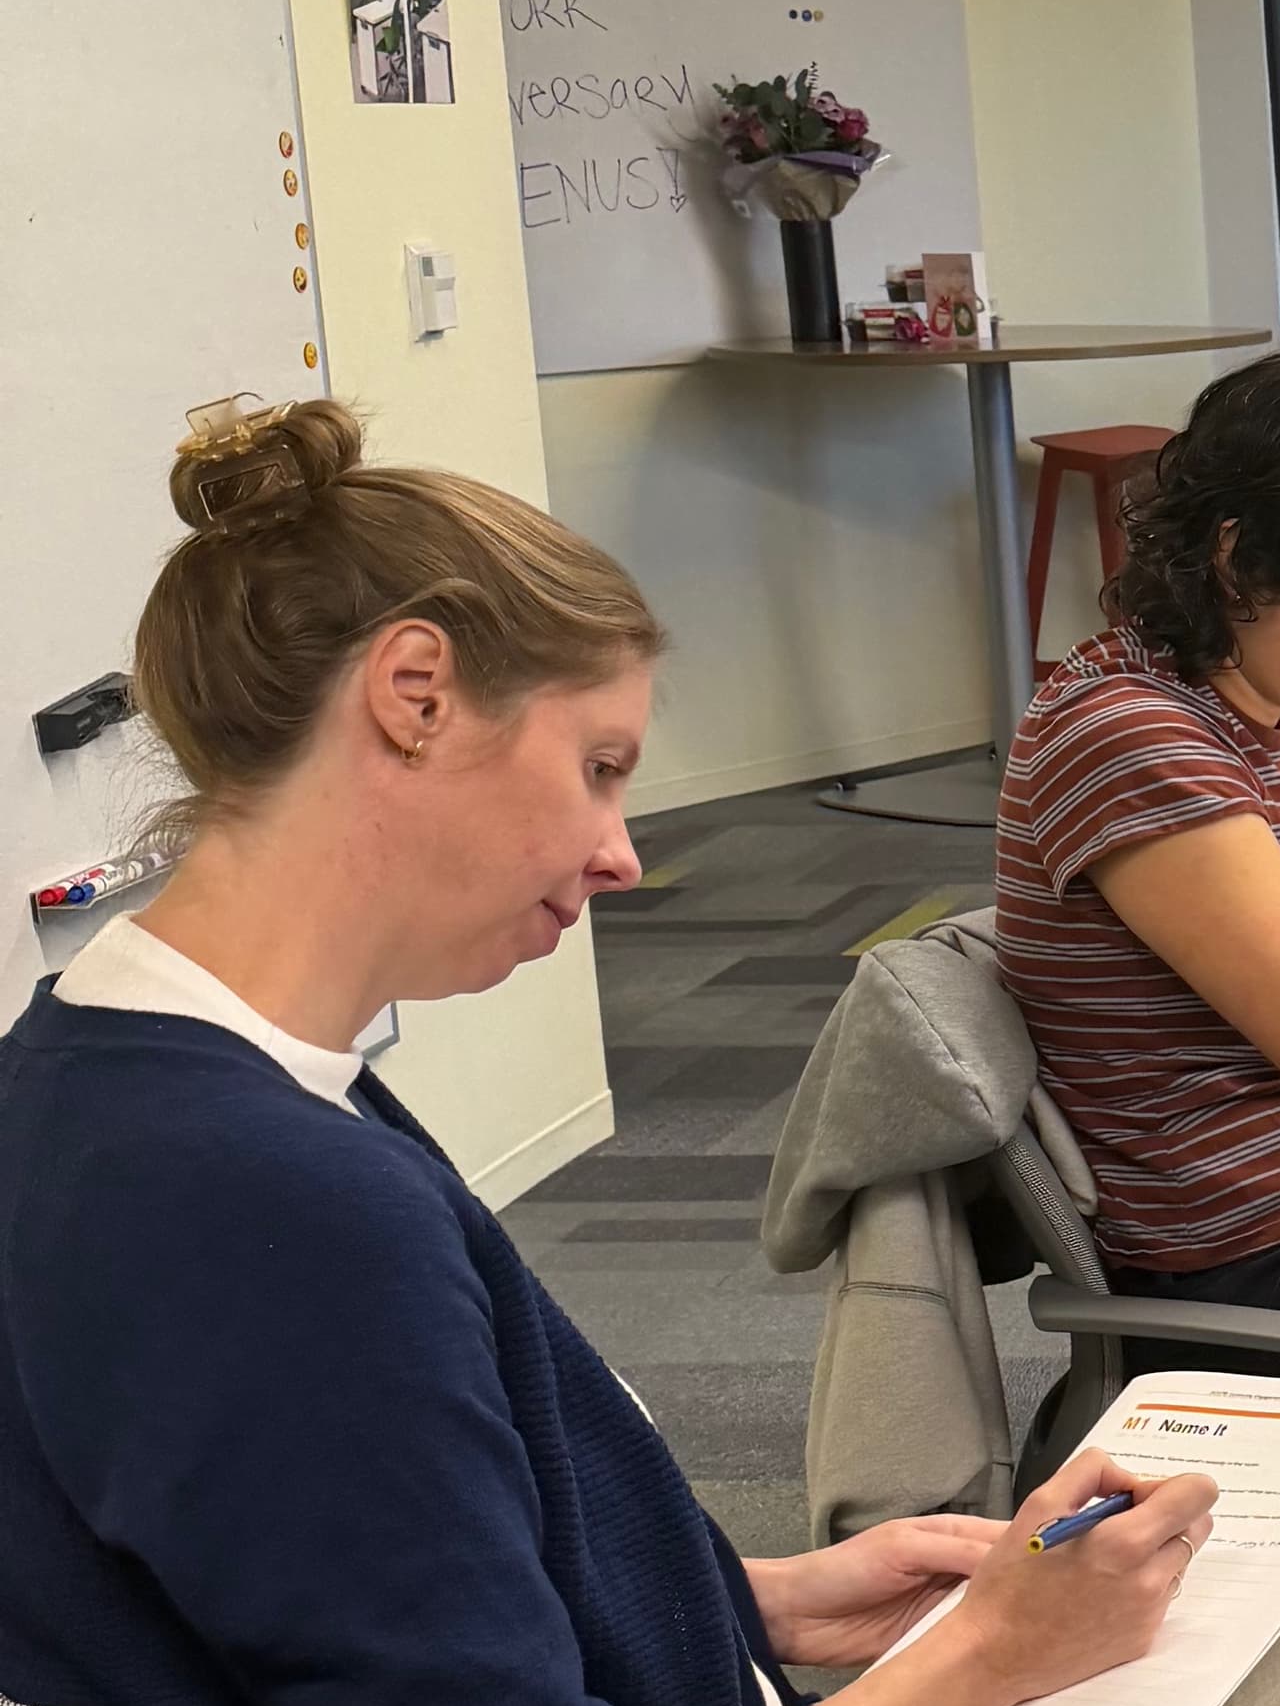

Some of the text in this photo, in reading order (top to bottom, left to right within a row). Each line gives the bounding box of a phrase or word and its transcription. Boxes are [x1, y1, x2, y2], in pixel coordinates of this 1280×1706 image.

[520, 146, 688, 229] ENUS!
[1121, 1415, 1151, 1431] M1
[1158, 1418, 1210, 1436] Name
[1212, 1422, 1229, 1438] It
